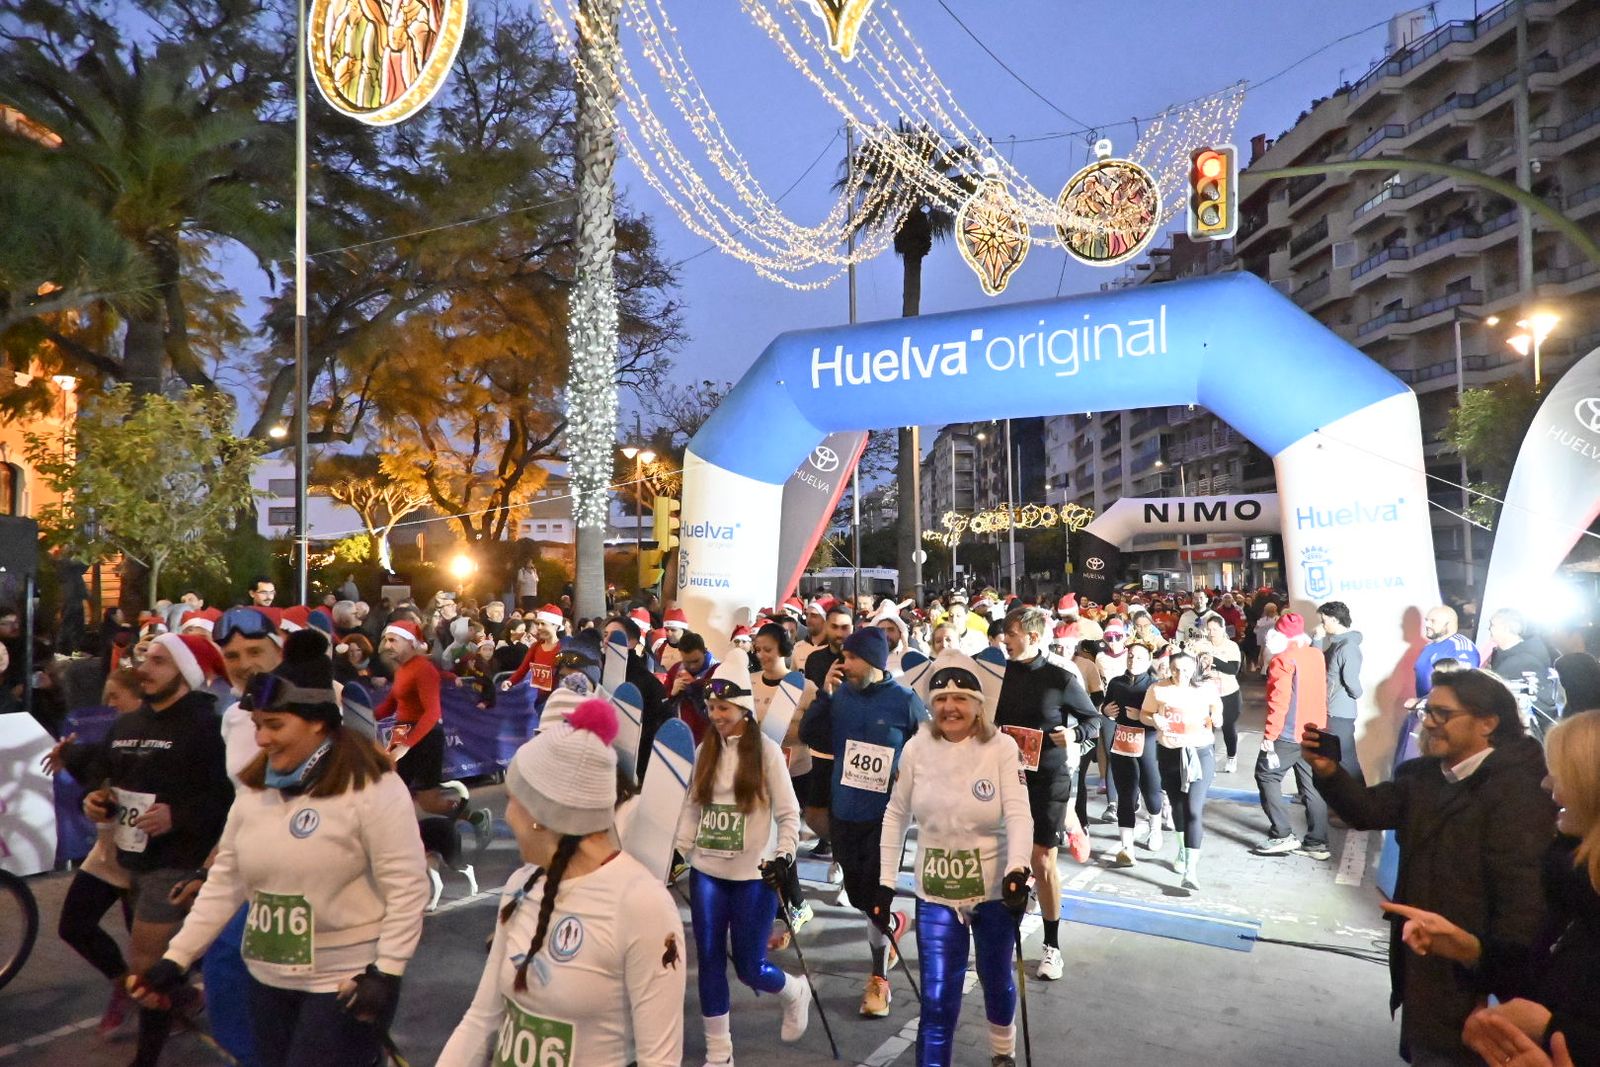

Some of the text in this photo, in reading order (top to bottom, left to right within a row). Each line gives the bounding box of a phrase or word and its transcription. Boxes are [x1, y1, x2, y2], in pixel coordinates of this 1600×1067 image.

[811, 304, 1169, 389] Huelva original
[794, 468, 830, 494] HUELVA
[1144, 499, 1262, 523] NIMO
[1296, 500, 1398, 530] Huelva
[690, 577, 730, 588] HUELVA
[1340, 576, 1405, 591] HUELVA
[850, 753, 883, 773] 480
[702, 810, 742, 831] 4007
[924, 856, 980, 880] 4002
[248, 902, 308, 936] 4016
